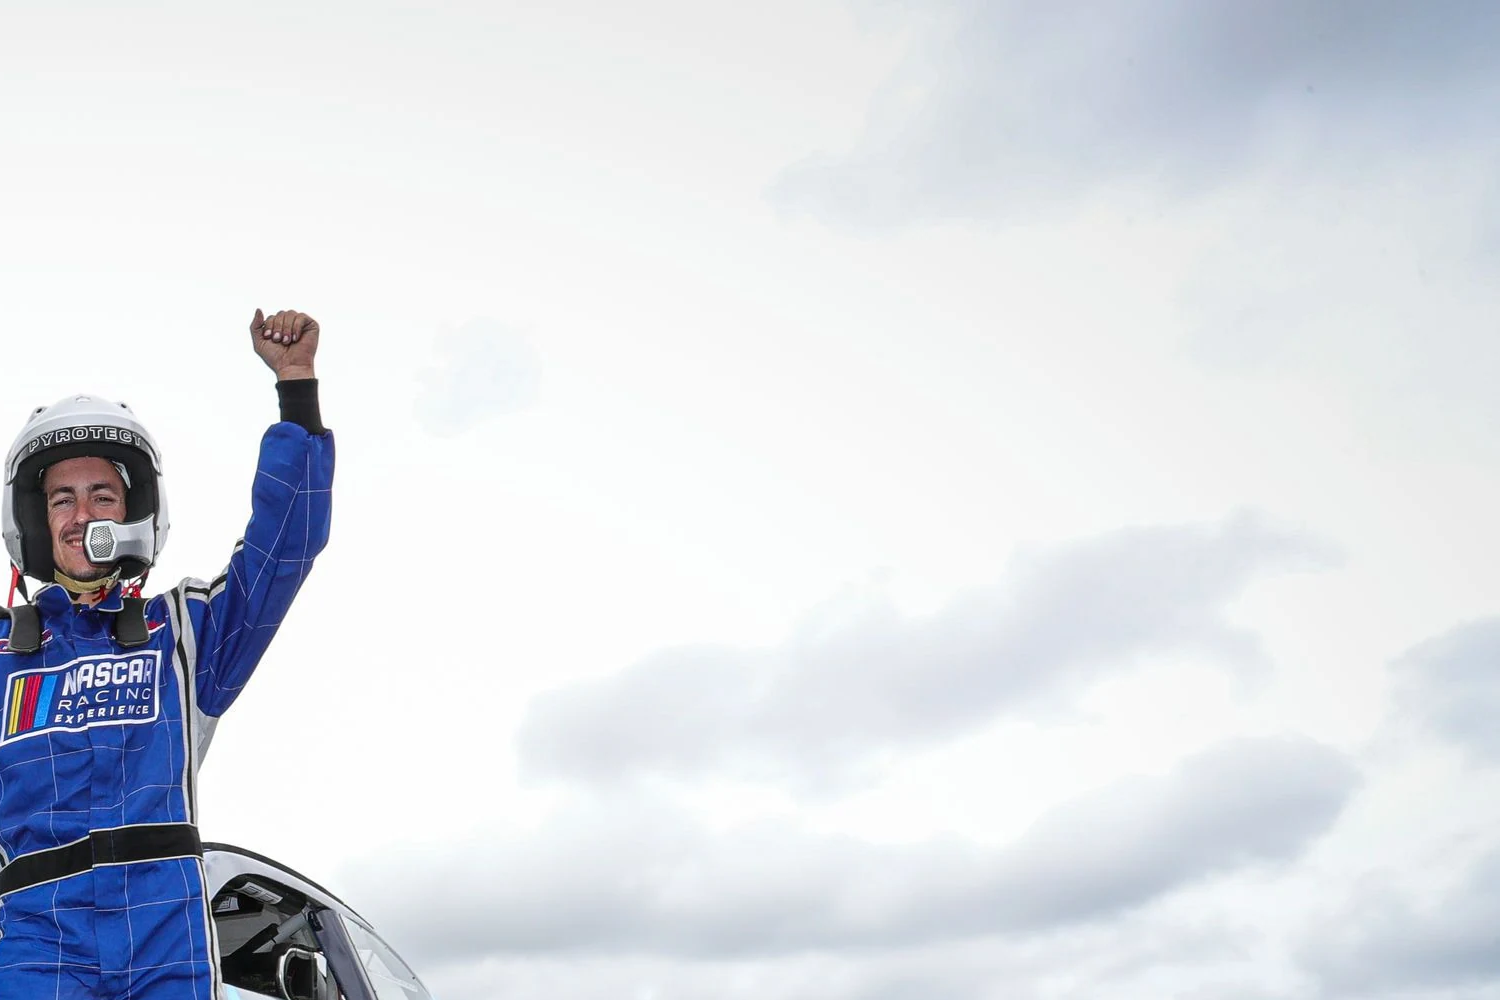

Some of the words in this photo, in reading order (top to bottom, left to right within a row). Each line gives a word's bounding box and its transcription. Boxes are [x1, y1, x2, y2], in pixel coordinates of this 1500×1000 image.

[28, 426, 142, 453] PYROTECT
[61, 658, 154, 697] NASCAR
[57, 688, 152, 711] RACING
[54, 705, 150, 724] EXPERIENCE
